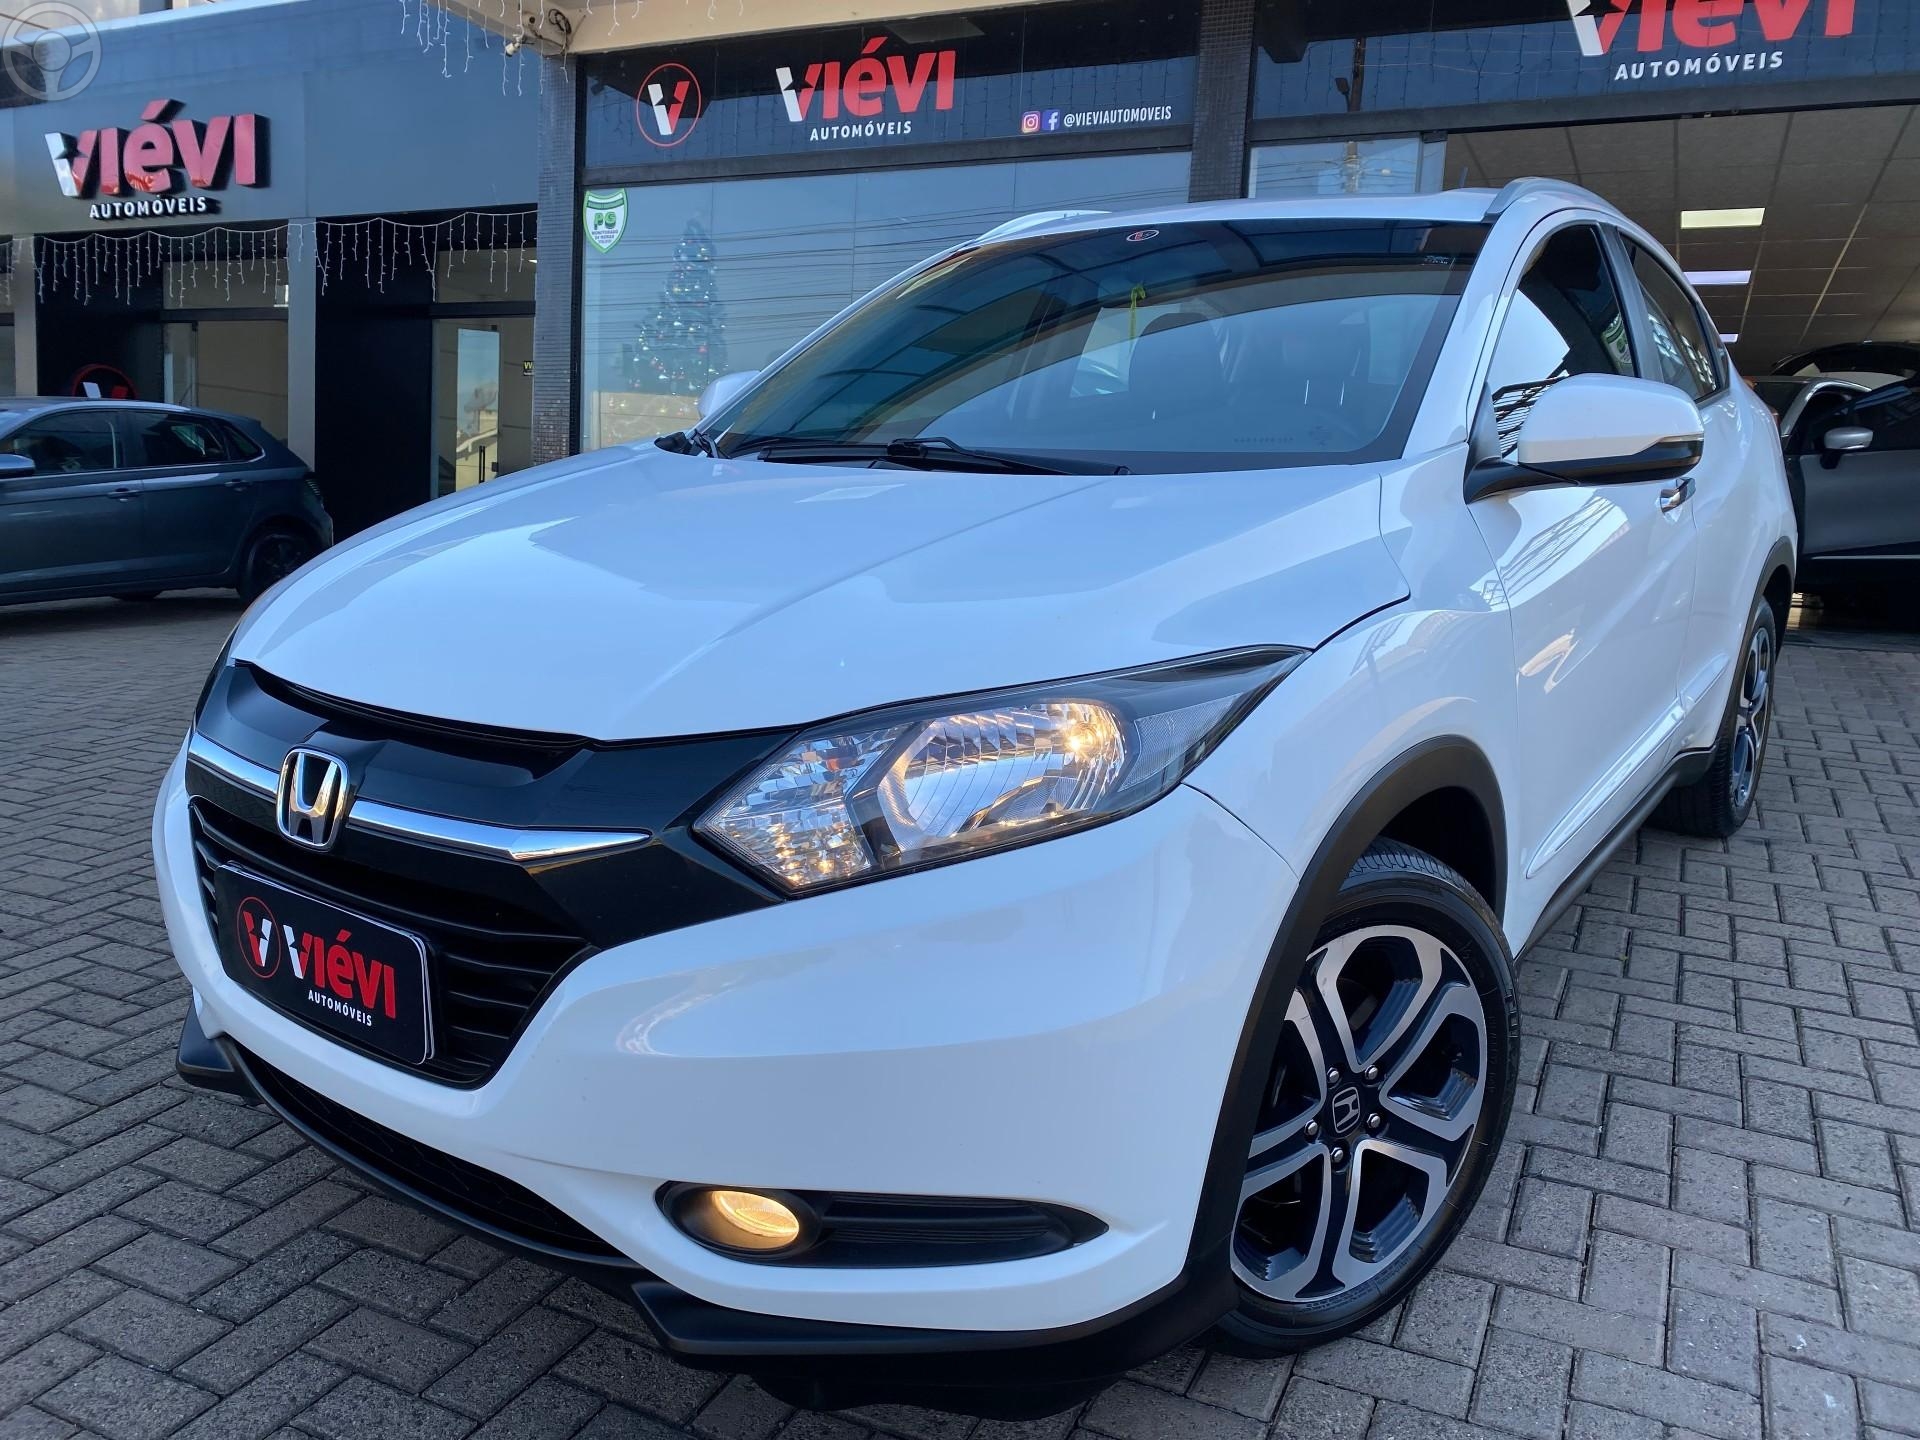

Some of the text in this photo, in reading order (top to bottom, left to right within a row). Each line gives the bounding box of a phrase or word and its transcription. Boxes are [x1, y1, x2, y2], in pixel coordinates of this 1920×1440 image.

[1615, 51, 1783, 81] AUTOMÓVEIS
[1064, 106, 1172, 127] @VIEVIAUTOMOVEIS
[810, 120, 912, 141] AUTOMÓVEIS
[89, 194, 206, 218] AUTOMÓVEIS
[308, 989, 373, 1027] AUTOMÓVEIS
